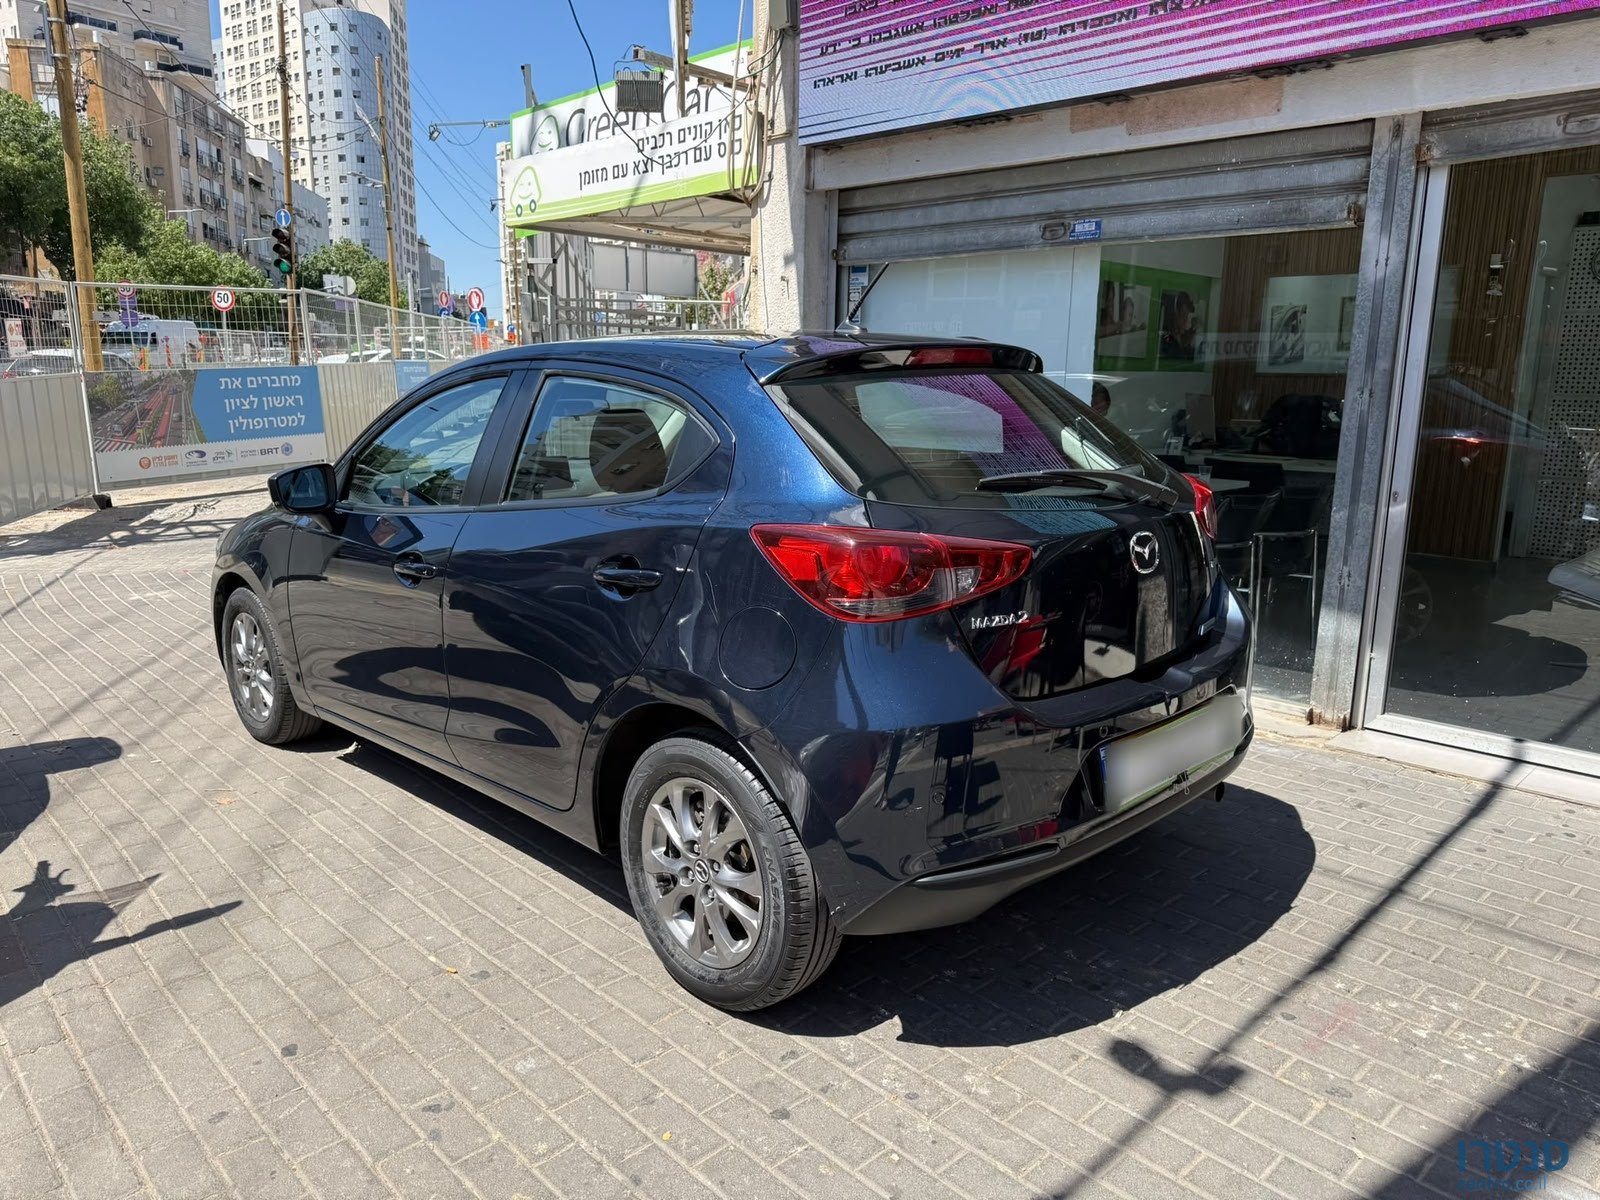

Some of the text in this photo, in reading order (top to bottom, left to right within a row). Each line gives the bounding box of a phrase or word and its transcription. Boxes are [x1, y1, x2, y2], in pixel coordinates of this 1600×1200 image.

[813, 71, 858, 89] ואראהו
[636, 131, 673, 153] רכבים
[678, 122, 713, 145] קונים
[693, 143, 712, 163] עם
[612, 163, 628, 180] עם
[632, 157, 654, 176] וצא
[579, 167, 608, 190] מזומן
[216, 292, 229, 304] 50
[219, 374, 301, 390] מחברים את
[224, 394, 304, 413] ראשון לציון
[228, 412, 306, 434] למטרופולין
[260, 447, 279, 456] BRT
